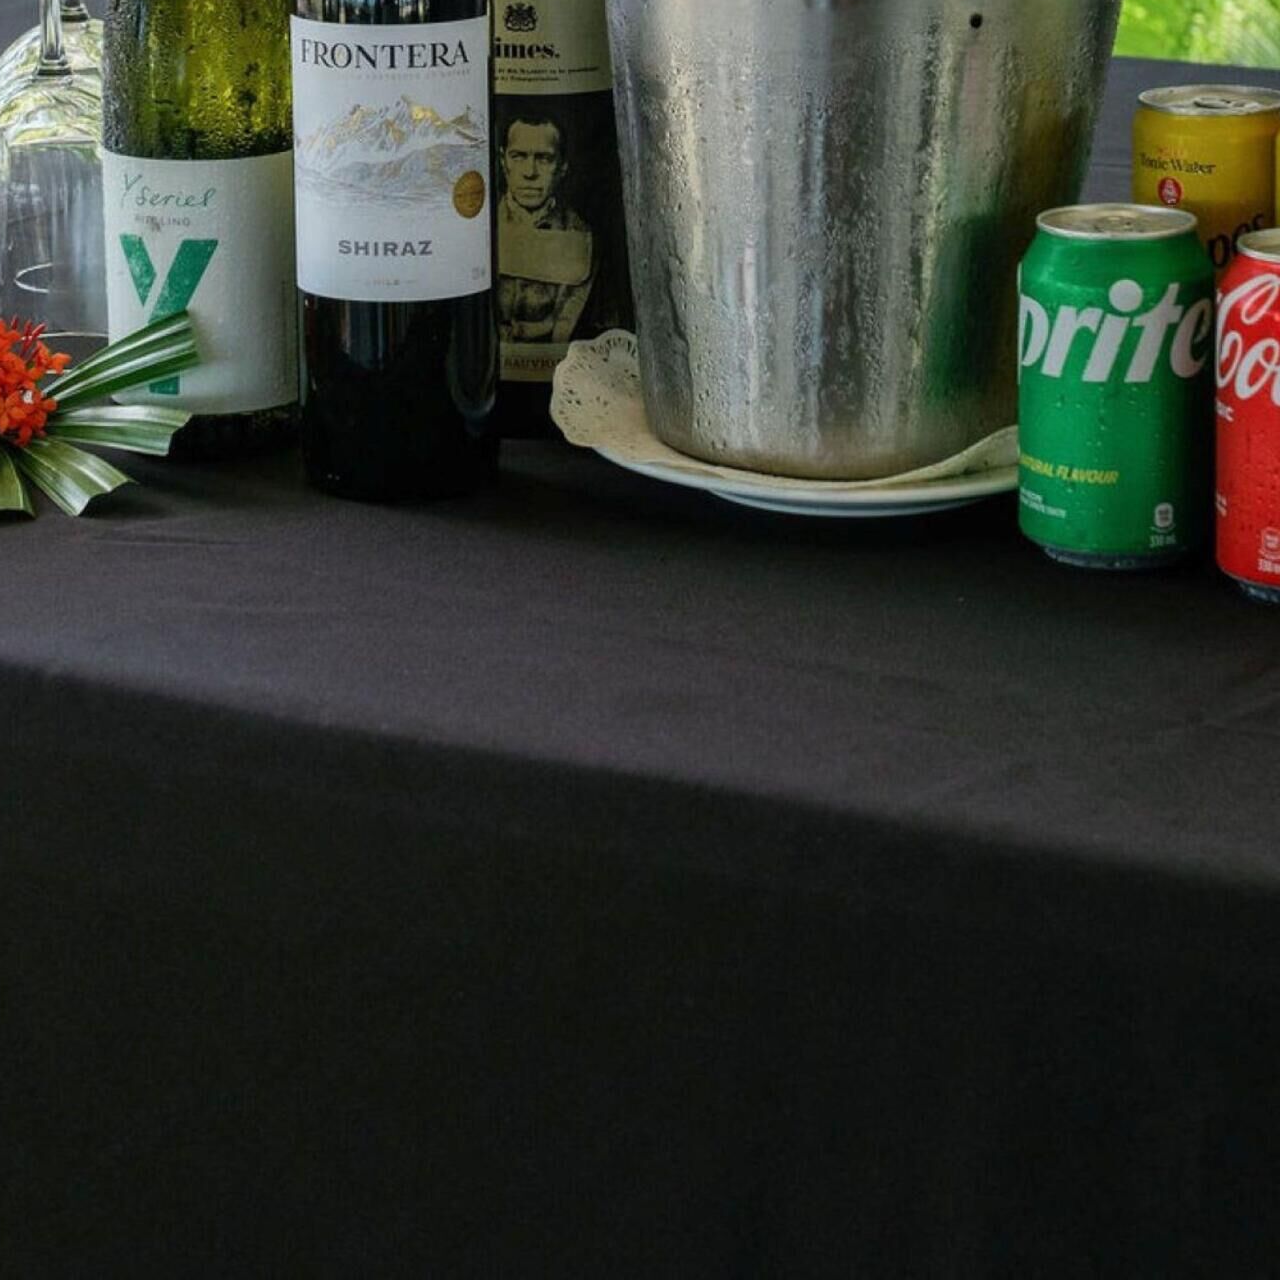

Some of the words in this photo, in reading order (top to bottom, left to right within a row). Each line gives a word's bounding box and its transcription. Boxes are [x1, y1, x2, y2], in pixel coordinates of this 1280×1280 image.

[301, 39, 470, 70] FRONTERA
[1139, 151, 1168, 171] Tonic
[1170, 158, 1216, 175] Water
[337, 239, 434, 258] SHIRAZ
[119, 234, 219, 395] Y
[1056, 464, 1119, 485] FLAVOUR
